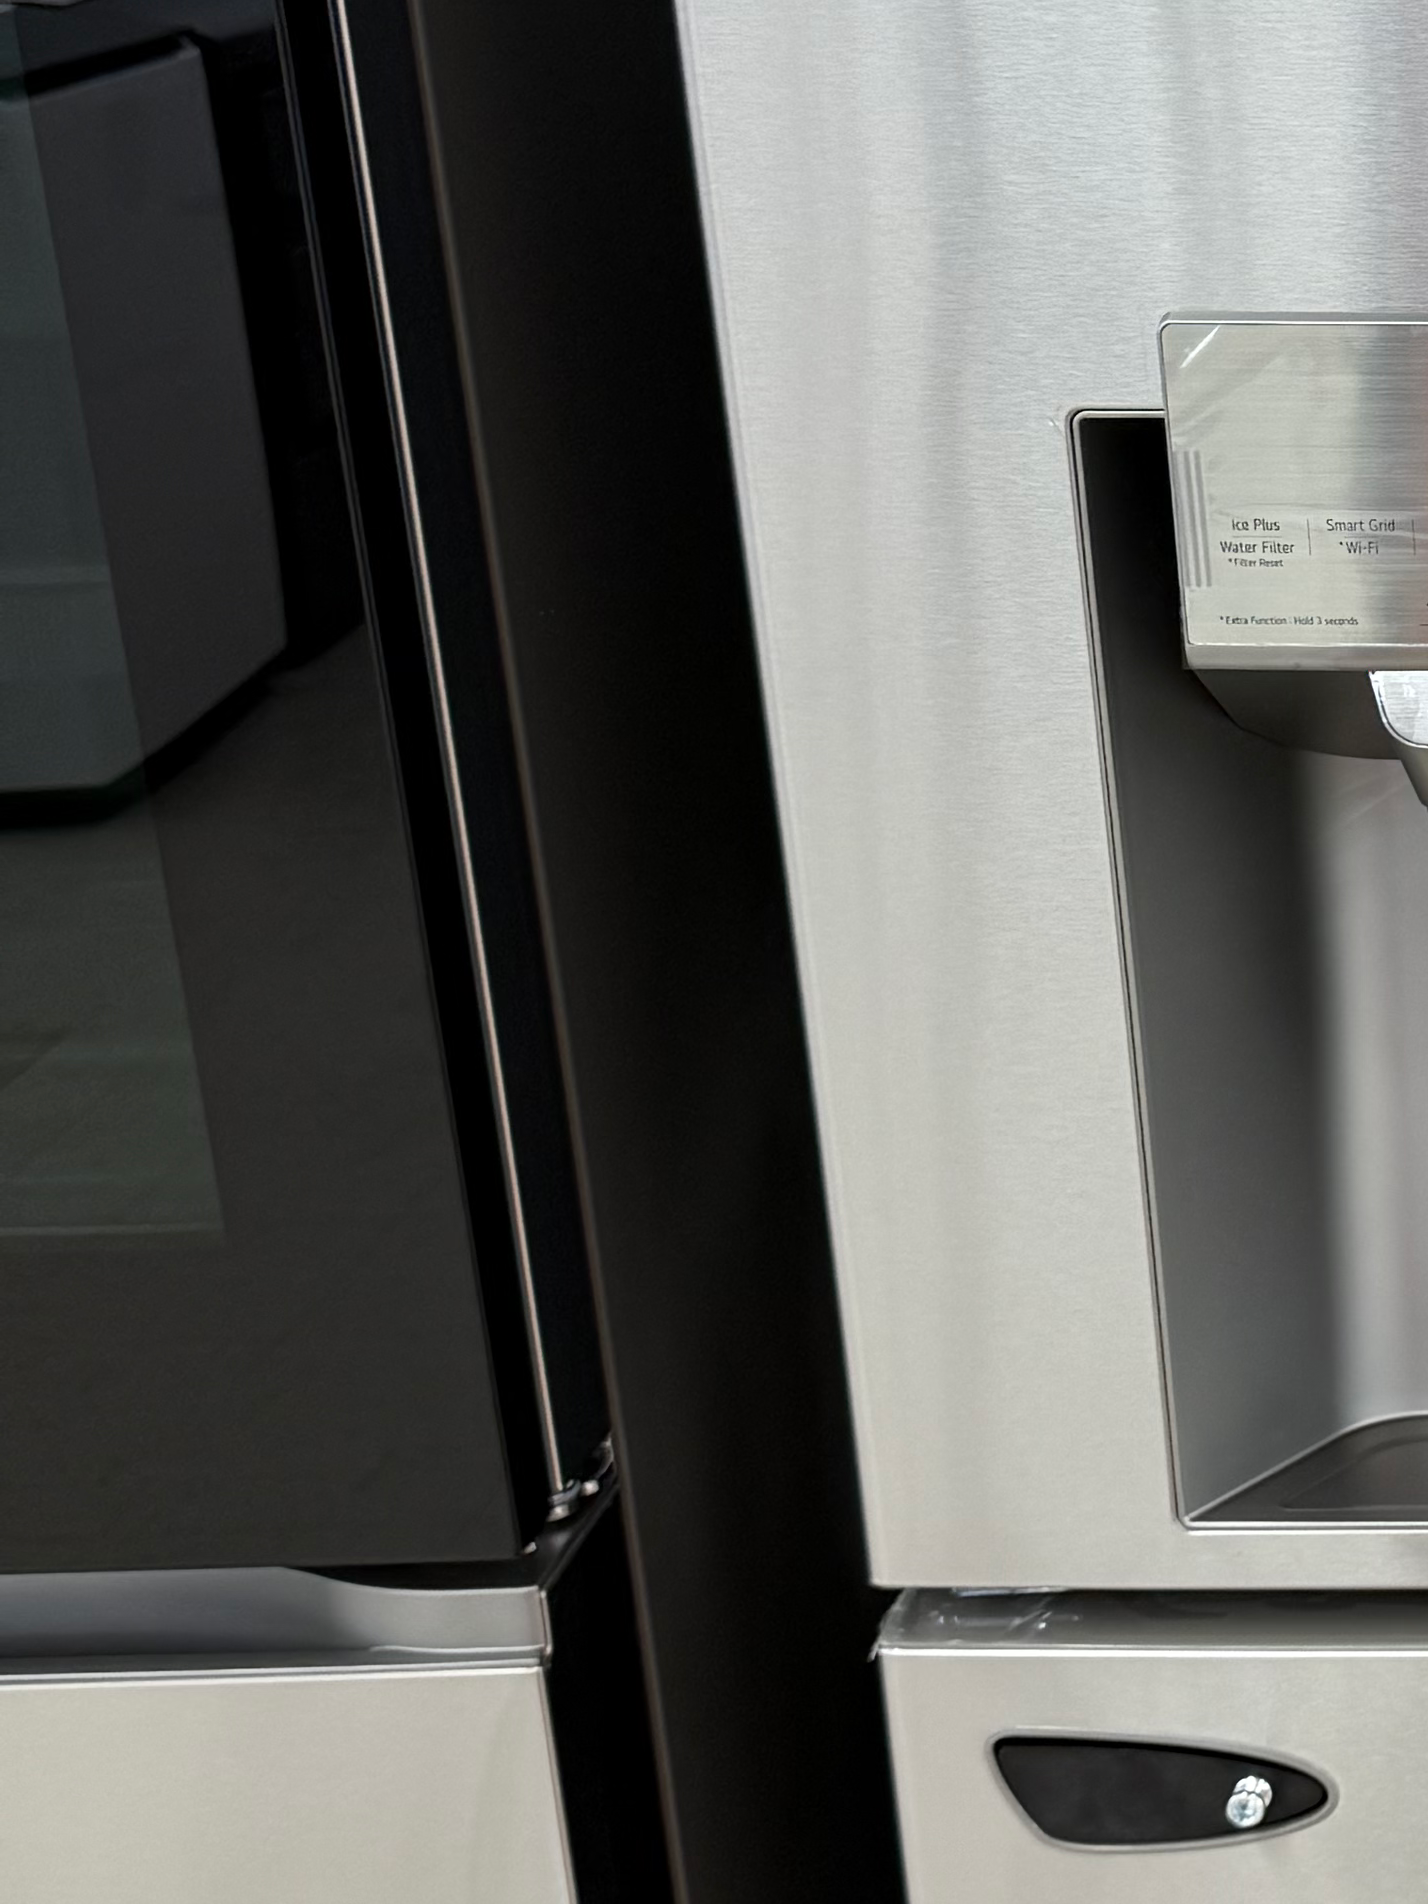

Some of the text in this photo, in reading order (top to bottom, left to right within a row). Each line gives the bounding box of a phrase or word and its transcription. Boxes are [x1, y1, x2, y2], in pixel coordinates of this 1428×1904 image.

[1232, 518, 1281, 531] Ice Plus
[1326, 518, 1396, 532] Smart Grid
[1220, 541, 1295, 554] Water Filter
[1259, 558, 1284, 567] Reset
[1251, 616, 1287, 625] Function
[1294, 616, 1314, 625] Hold
[1324, 616, 1359, 626] seconds
